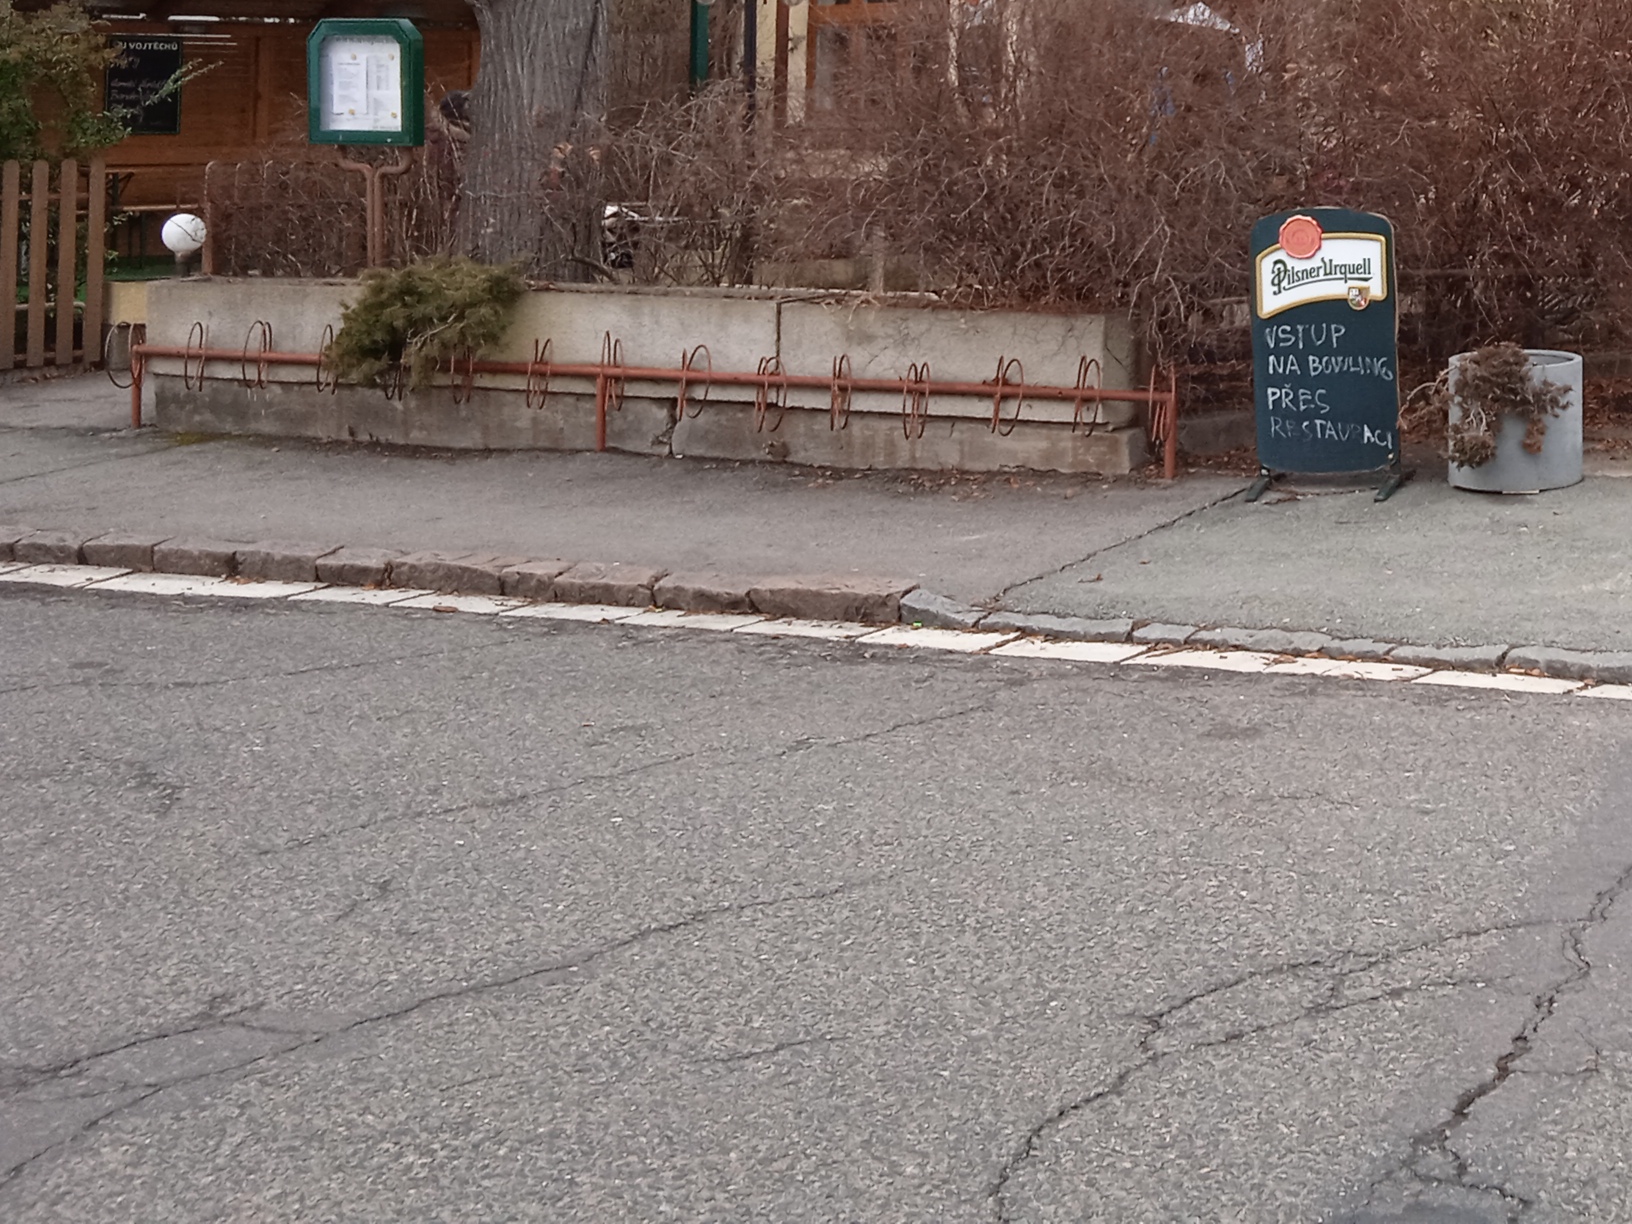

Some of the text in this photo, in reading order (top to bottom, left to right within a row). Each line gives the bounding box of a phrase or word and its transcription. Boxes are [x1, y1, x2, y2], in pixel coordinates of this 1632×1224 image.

[1271, 257, 1372, 296] Pilsner Urquell
[1265, 322, 1346, 350] VSTUP
[1268, 354, 1394, 381] NA BOWLING
[1266, 383, 1331, 414] PŘES
